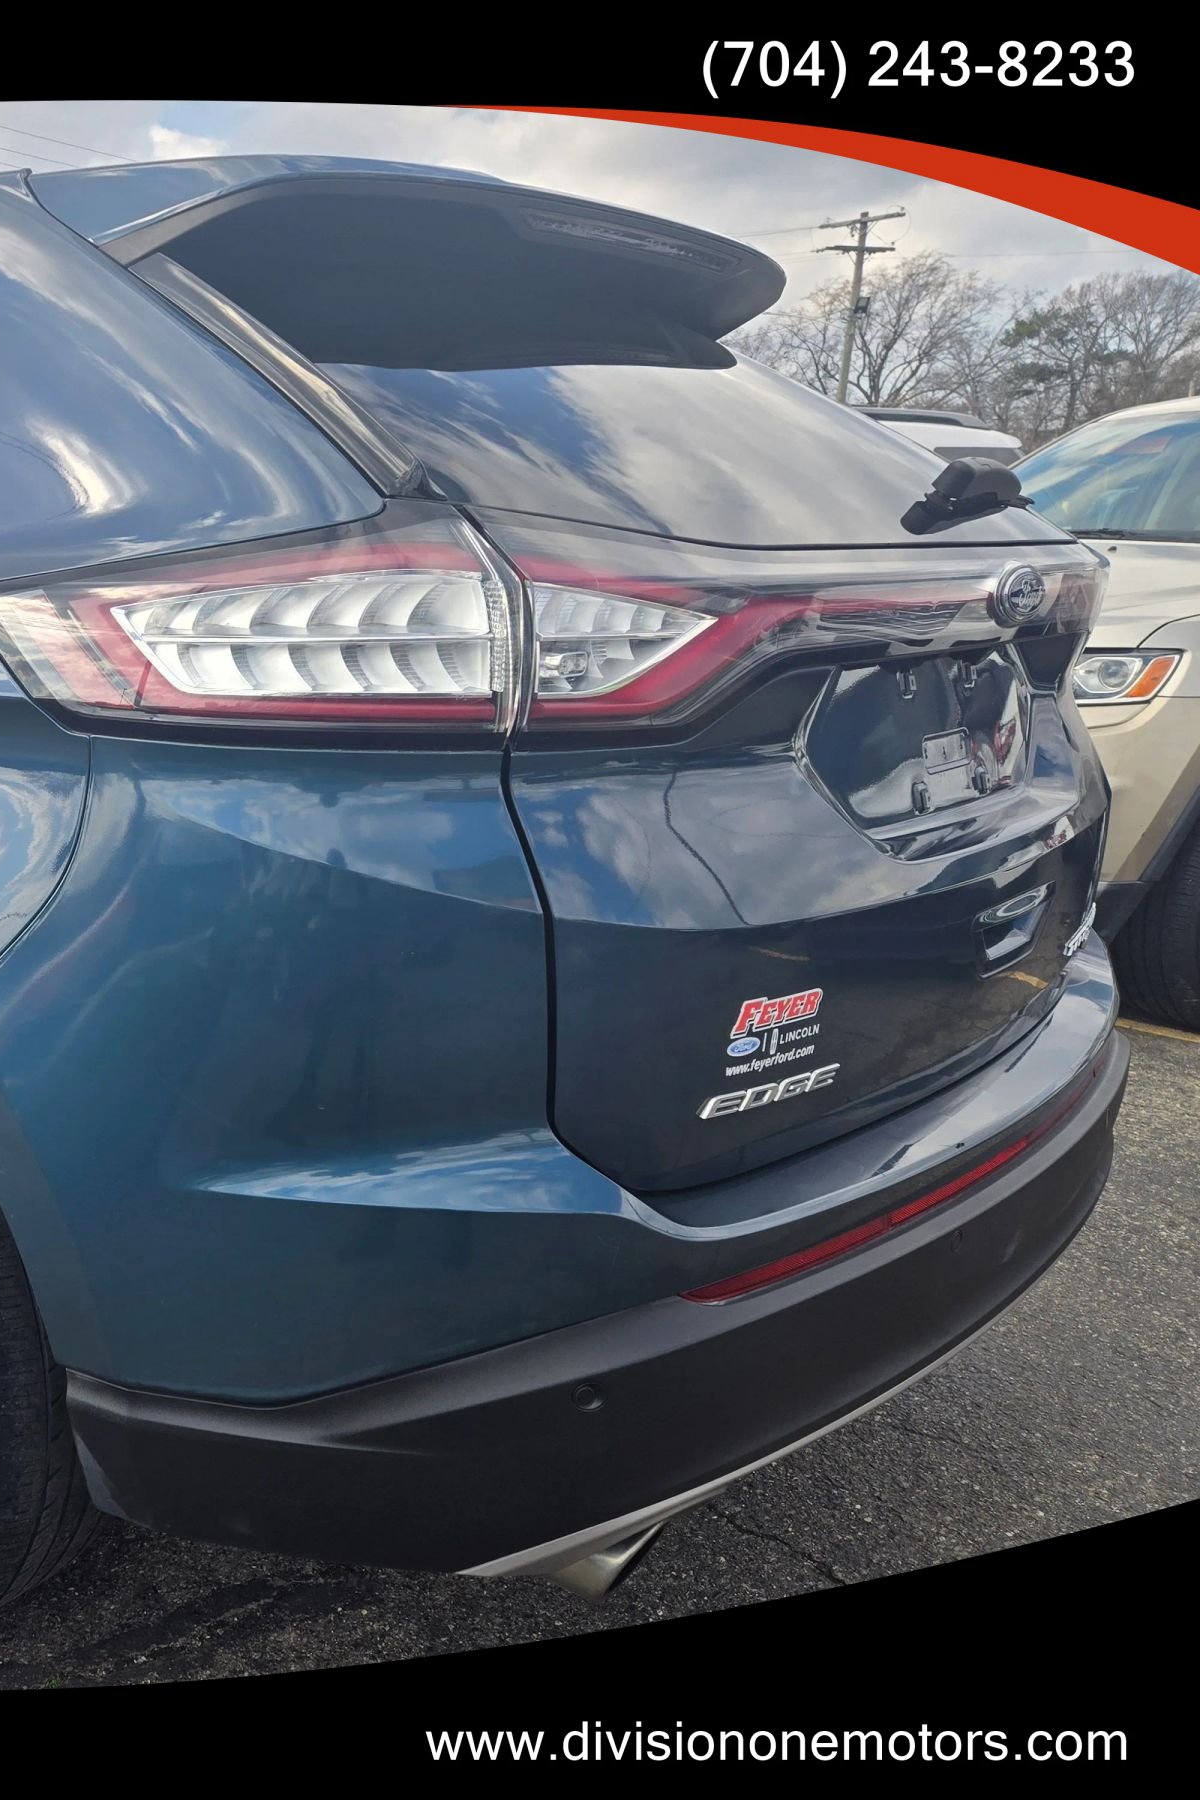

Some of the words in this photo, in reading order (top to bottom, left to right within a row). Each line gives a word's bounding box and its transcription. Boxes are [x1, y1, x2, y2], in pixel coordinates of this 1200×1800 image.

[730, 988, 824, 1039] FEYER
[731, 1039, 758, 1054] Ford
[779, 1023, 821, 1045] LINCOLN
[725, 1045, 815, 1077] www.feyerford.com
[699, 1063, 841, 1120] EDGE
